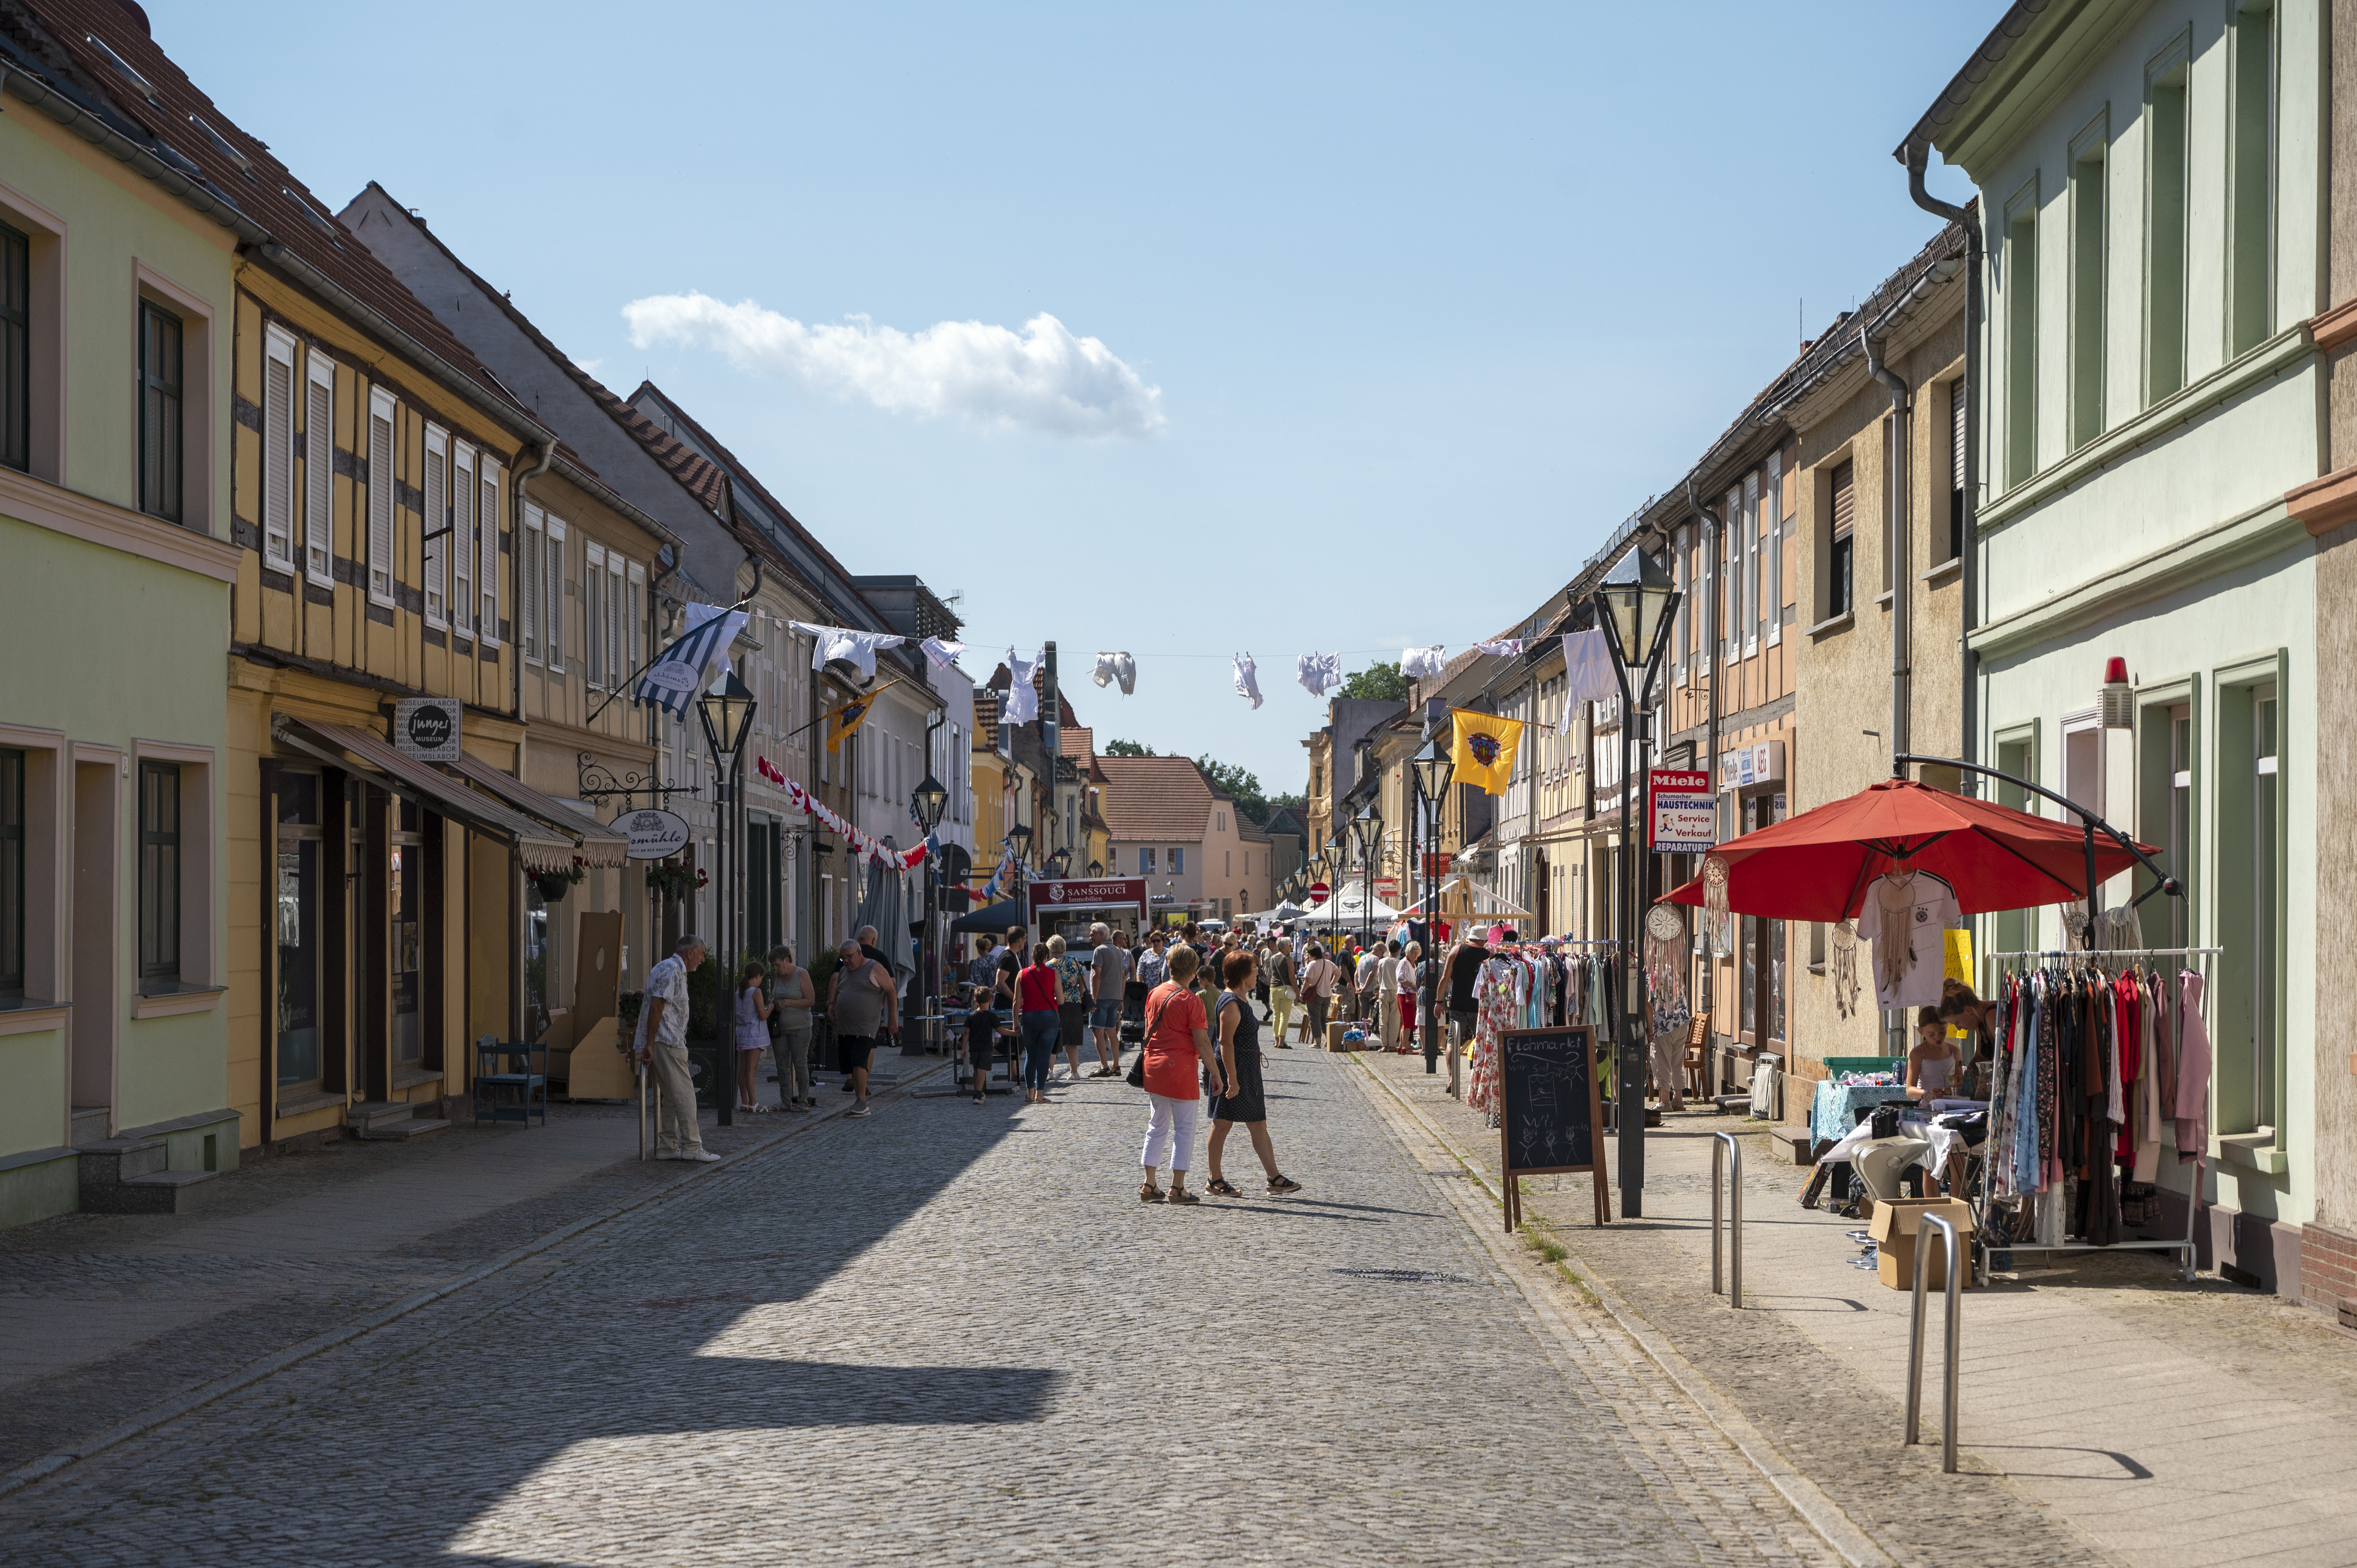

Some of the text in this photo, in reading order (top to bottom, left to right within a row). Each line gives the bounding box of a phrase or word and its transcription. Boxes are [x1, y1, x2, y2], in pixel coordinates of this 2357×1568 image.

[410, 712, 449, 736] junges
[1758, 749, 1767, 775] AEG
[1724, 758, 1738, 783] Miele
[1652, 775, 1706, 786] Miele
[1657, 800, 1714, 810] HAUSTECHNIK
[1678, 814, 1710, 823] Service
[1068, 886, 1126, 896] SANSSOUCI
[1507, 1036, 1581, 1054] Flohmarkt
